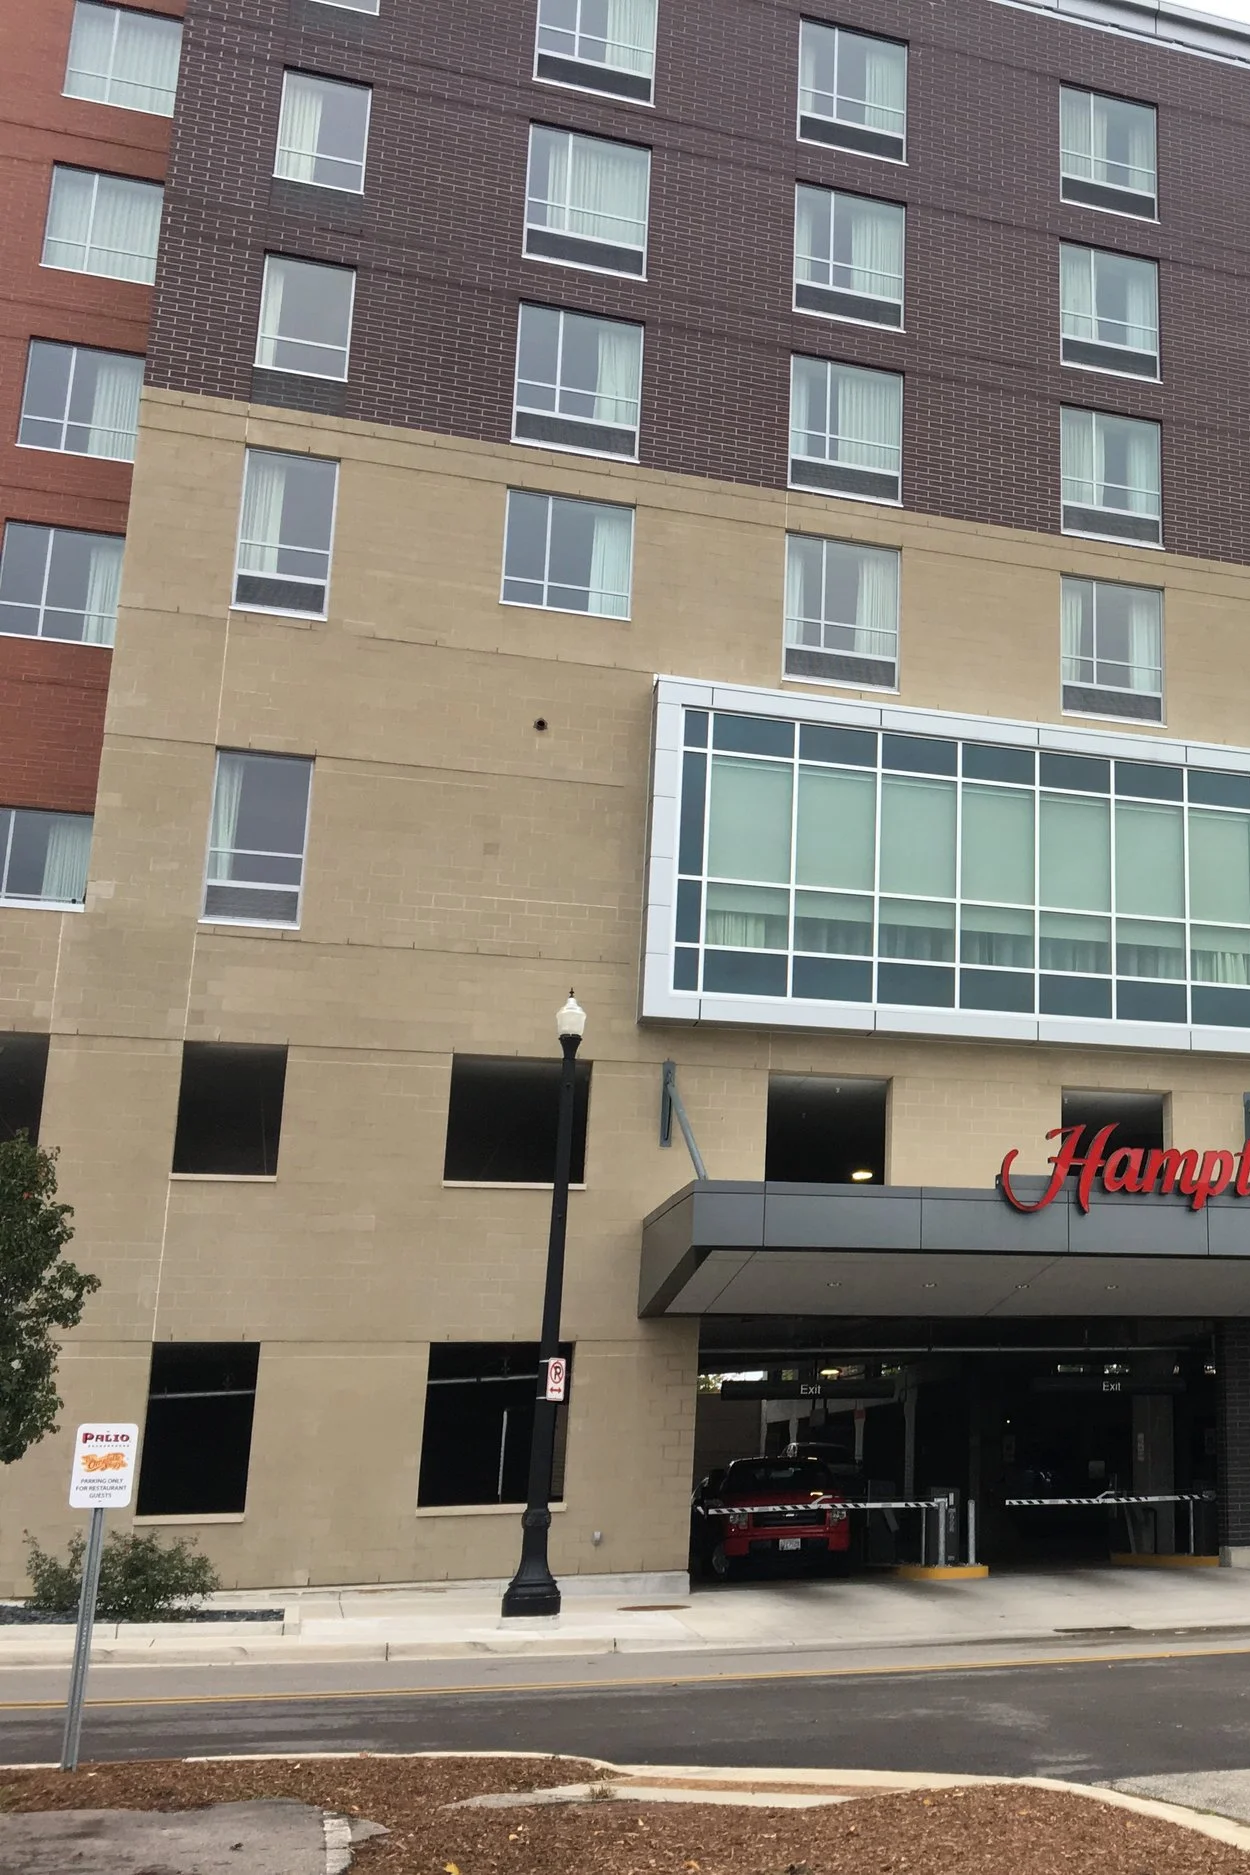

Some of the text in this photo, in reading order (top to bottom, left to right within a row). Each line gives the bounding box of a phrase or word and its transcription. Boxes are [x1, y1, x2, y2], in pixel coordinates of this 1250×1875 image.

[800, 1384, 821, 1395] Exit
[1102, 1381, 1121, 1391] Exit
[82, 1432, 130, 1444] PALIO
